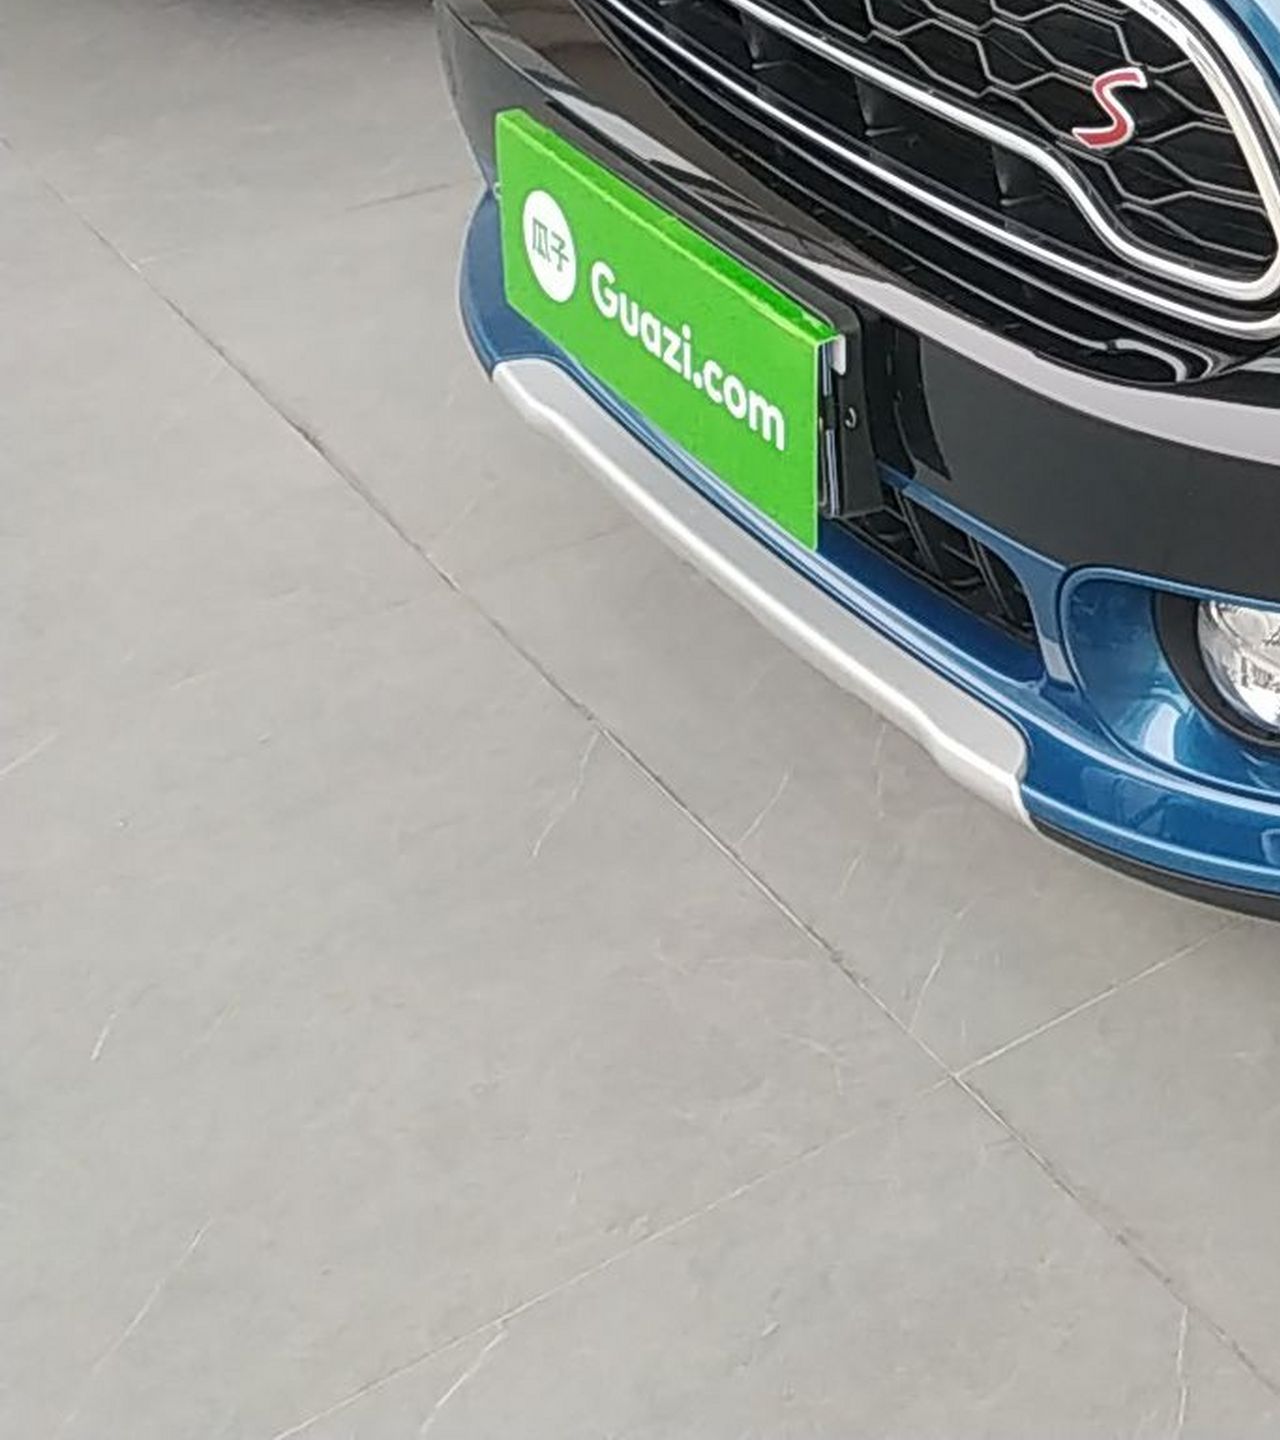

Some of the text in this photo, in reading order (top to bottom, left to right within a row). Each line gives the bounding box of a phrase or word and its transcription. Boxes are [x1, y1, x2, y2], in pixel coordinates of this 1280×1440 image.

[1072, 67, 1148, 149] S
[531, 216, 786, 451] 瓜子 Guazi.com
